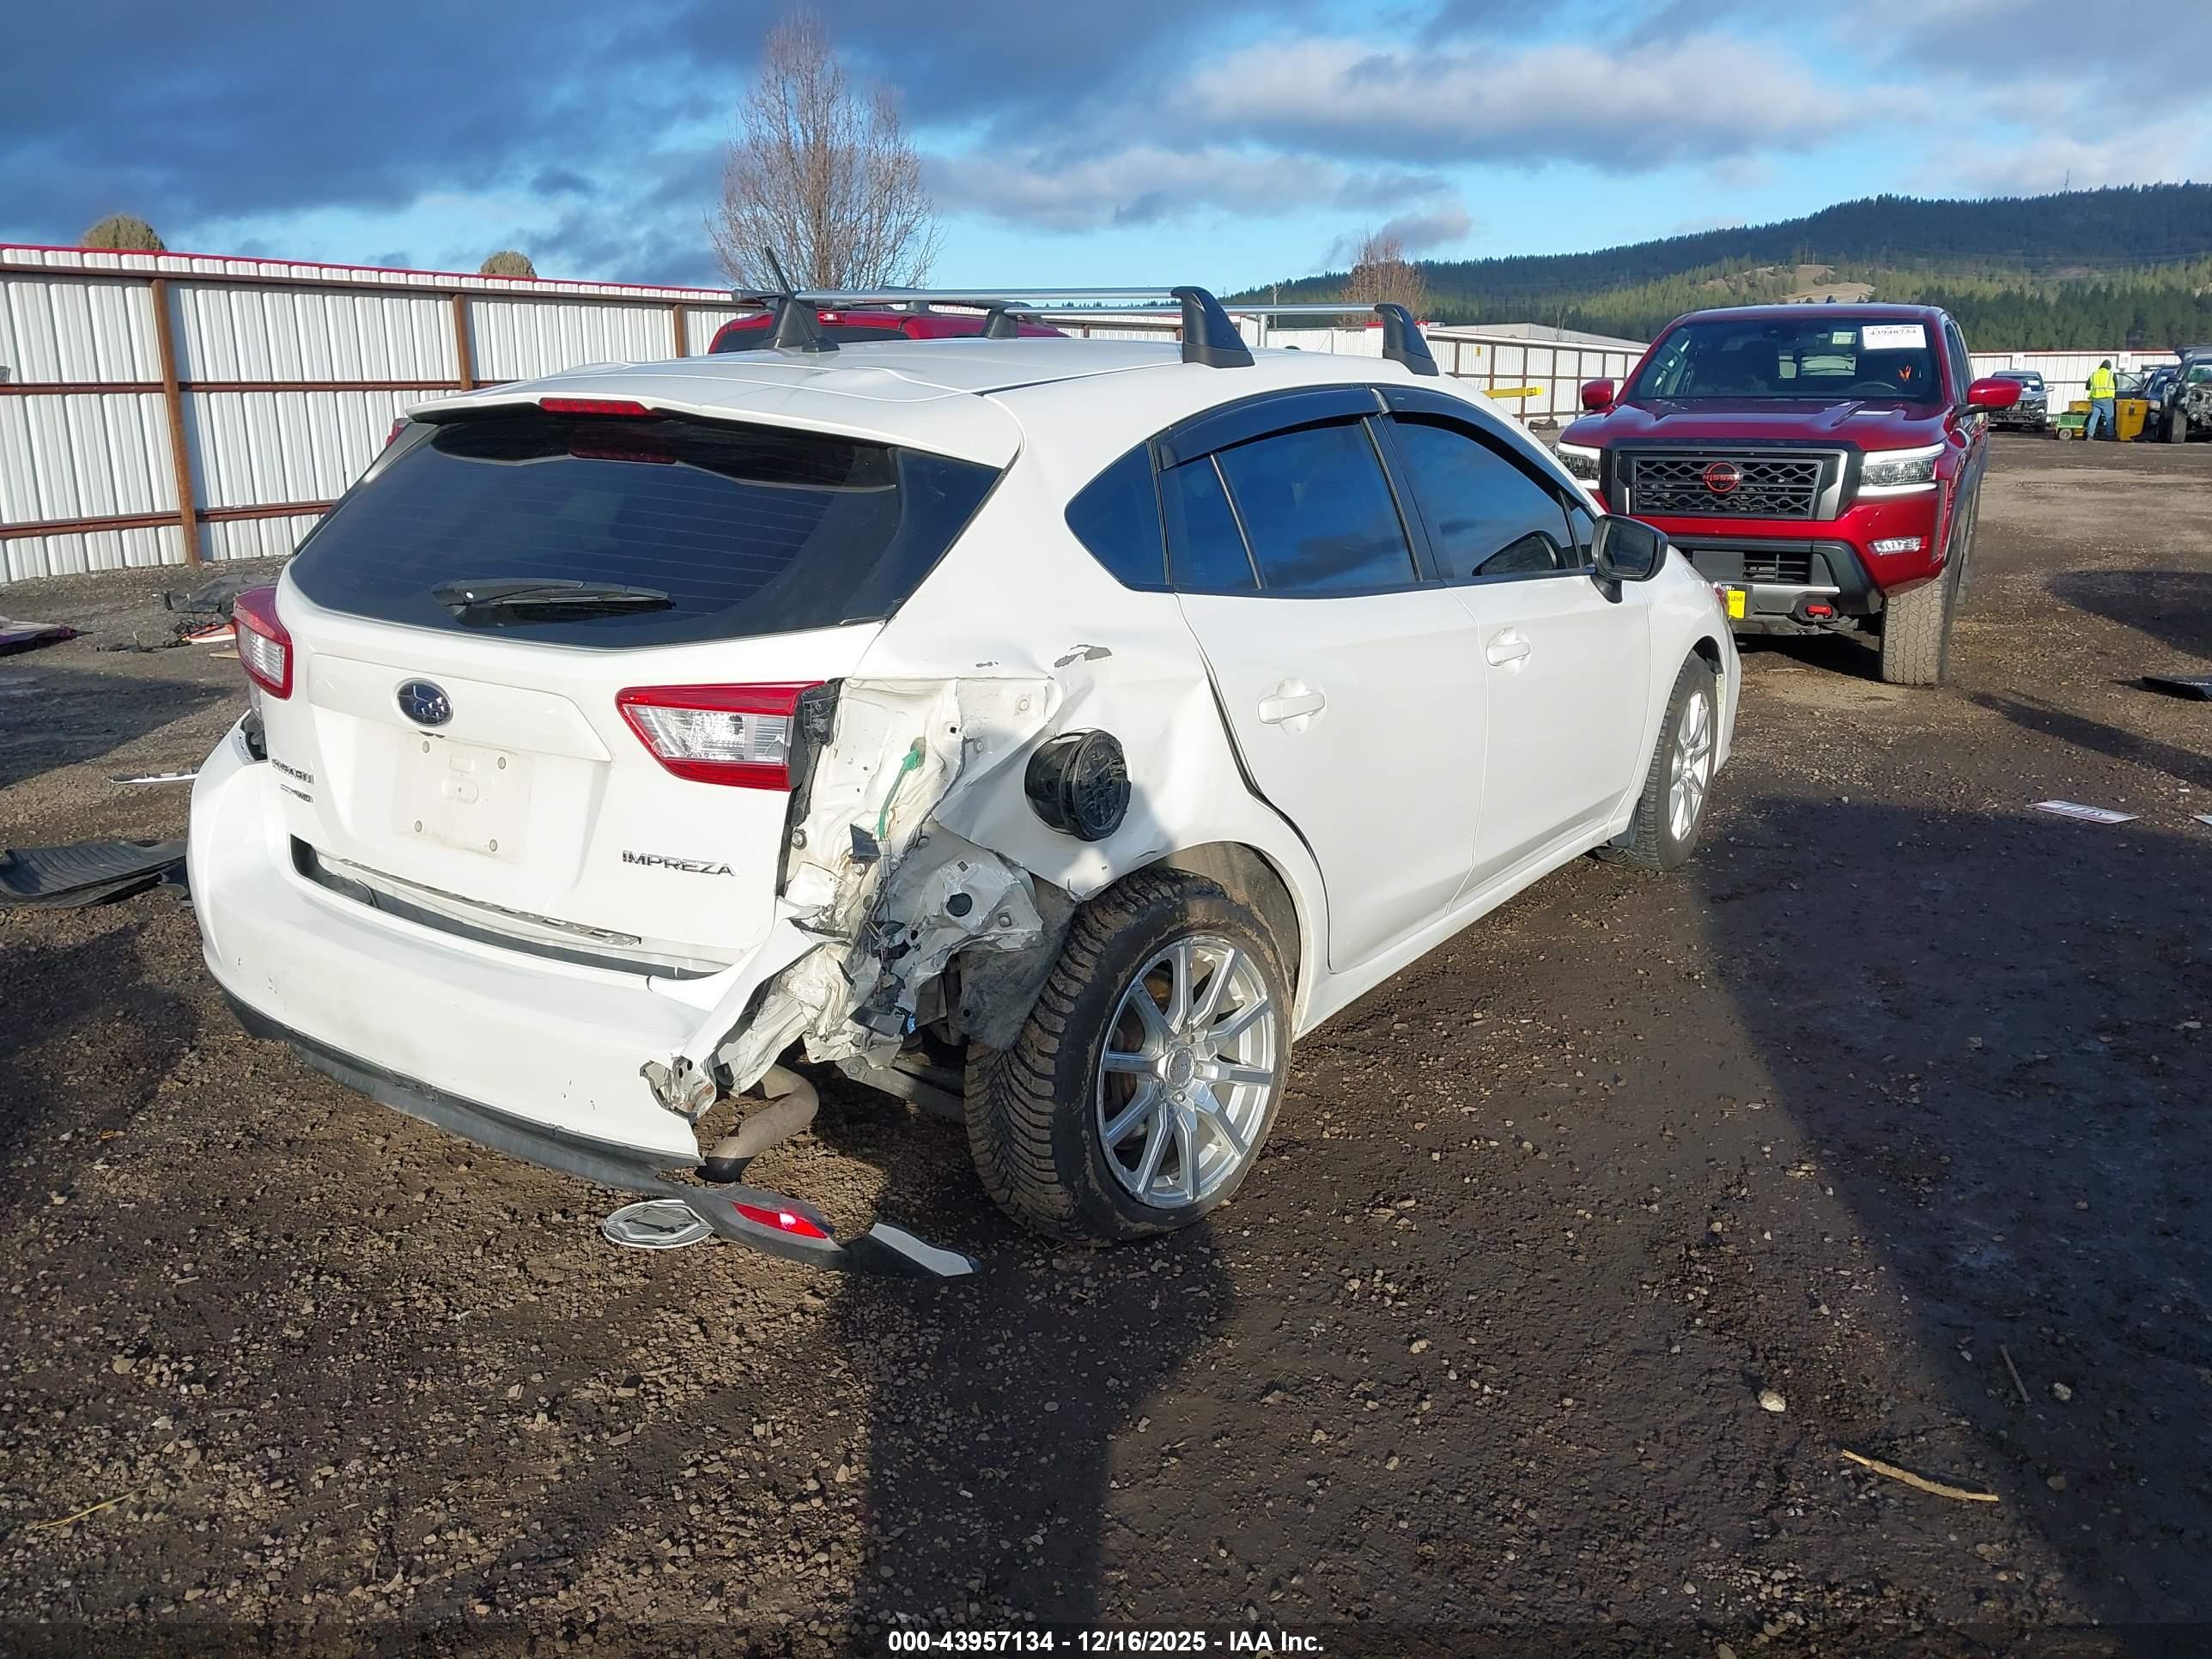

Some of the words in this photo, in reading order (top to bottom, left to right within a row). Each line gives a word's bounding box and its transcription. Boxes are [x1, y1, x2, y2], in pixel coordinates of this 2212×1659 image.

[1703, 473, 1744, 482] NISSAN
[271, 758, 315, 784] SUBARU
[622, 849, 737, 877] IMPREZA
